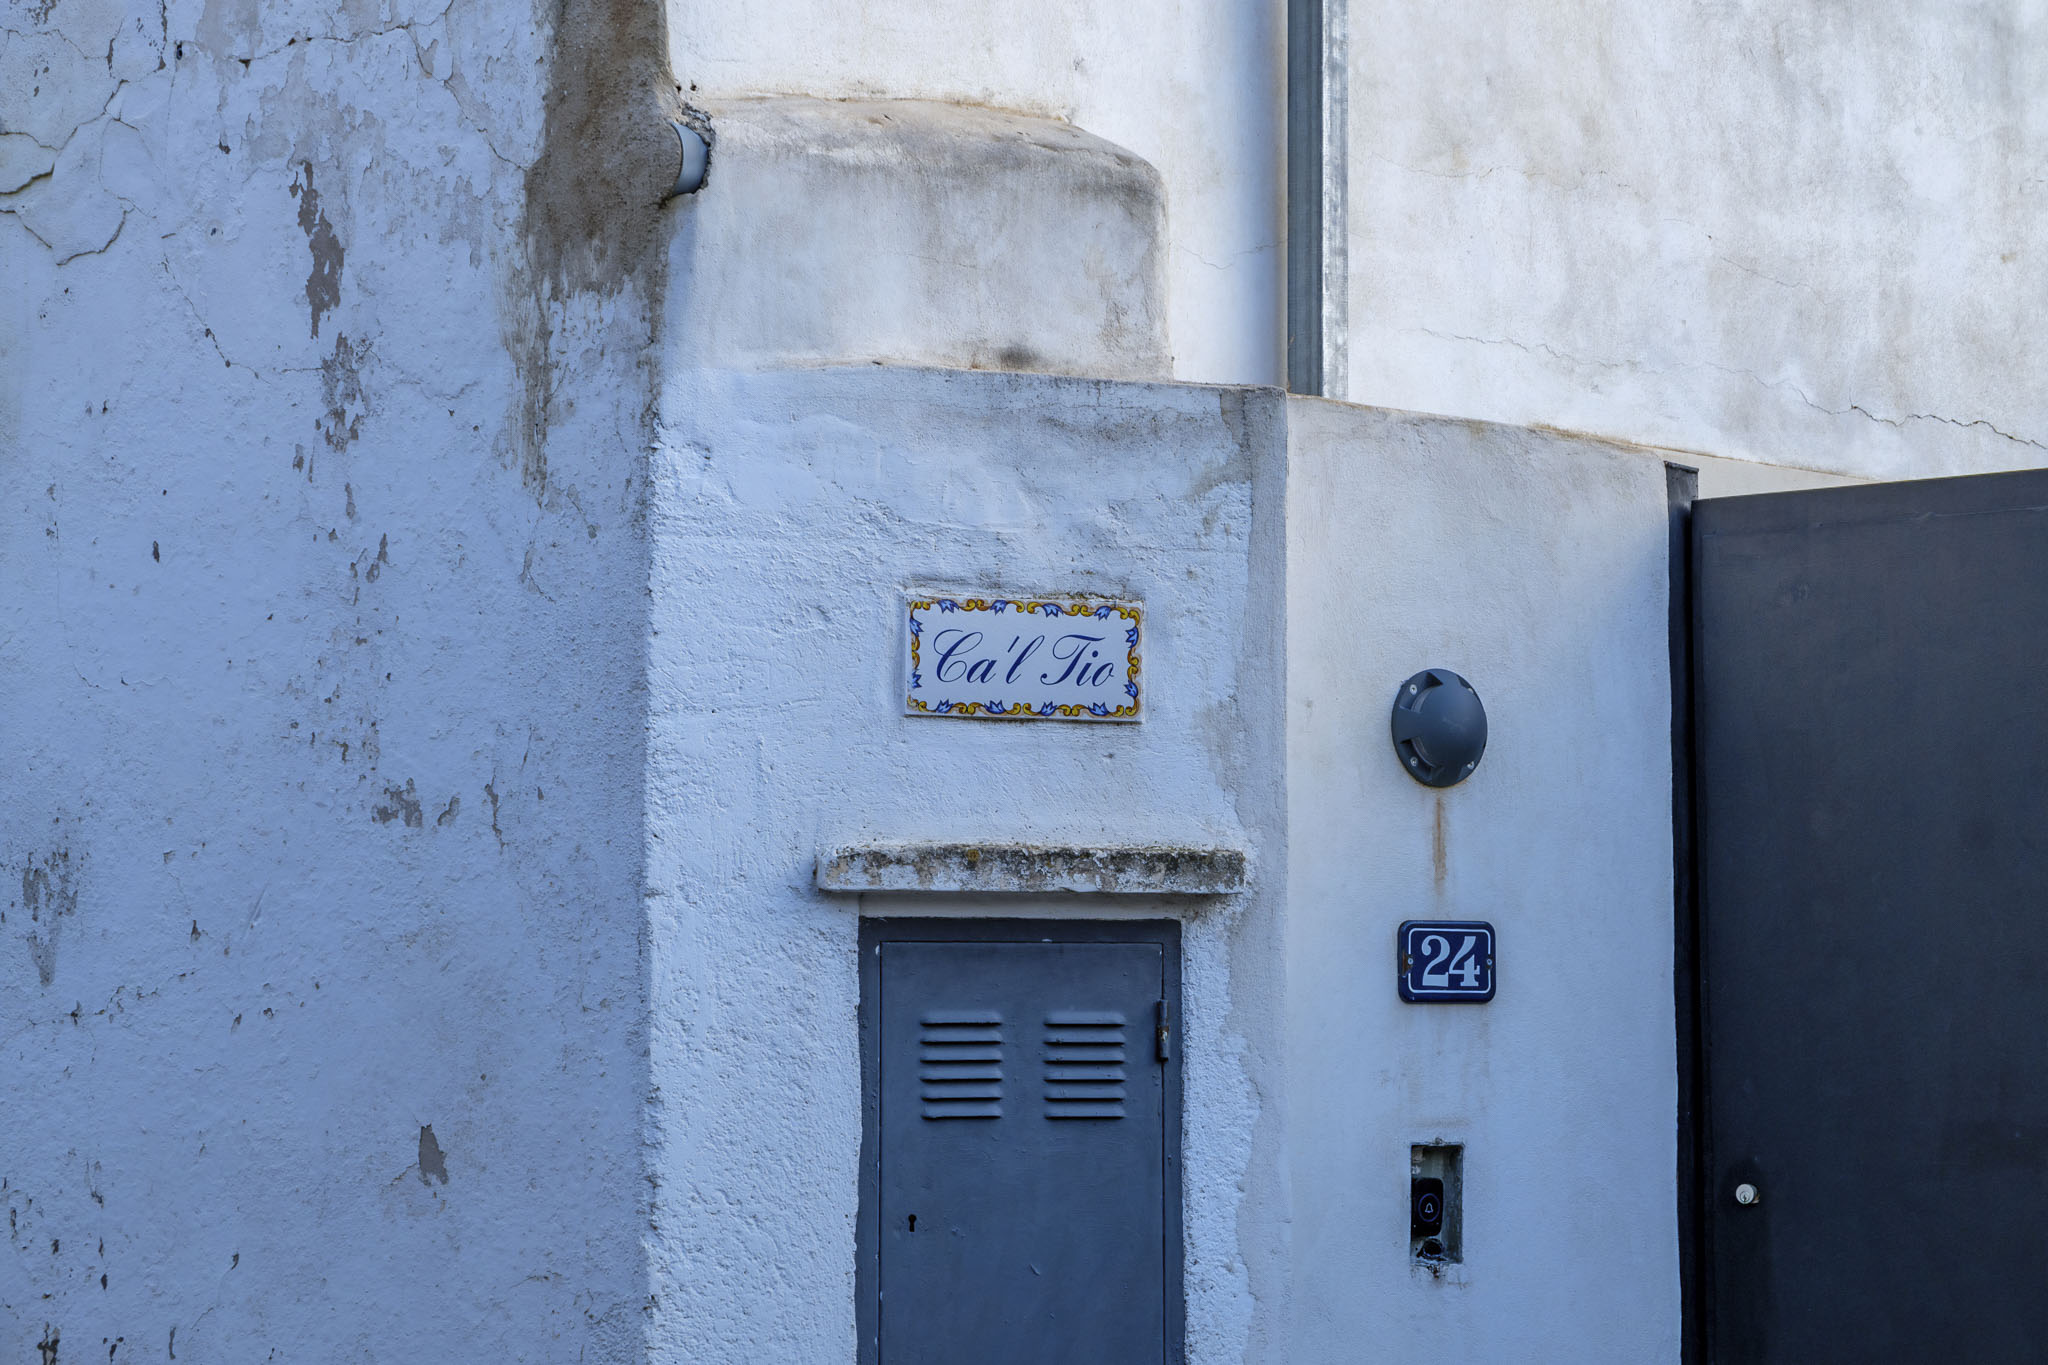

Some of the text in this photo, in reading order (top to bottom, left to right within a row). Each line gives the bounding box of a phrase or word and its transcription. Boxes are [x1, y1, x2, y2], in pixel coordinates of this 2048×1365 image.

[933, 628, 1114, 687] Ca'l Tio
[1421, 934, 1480, 987] 24
